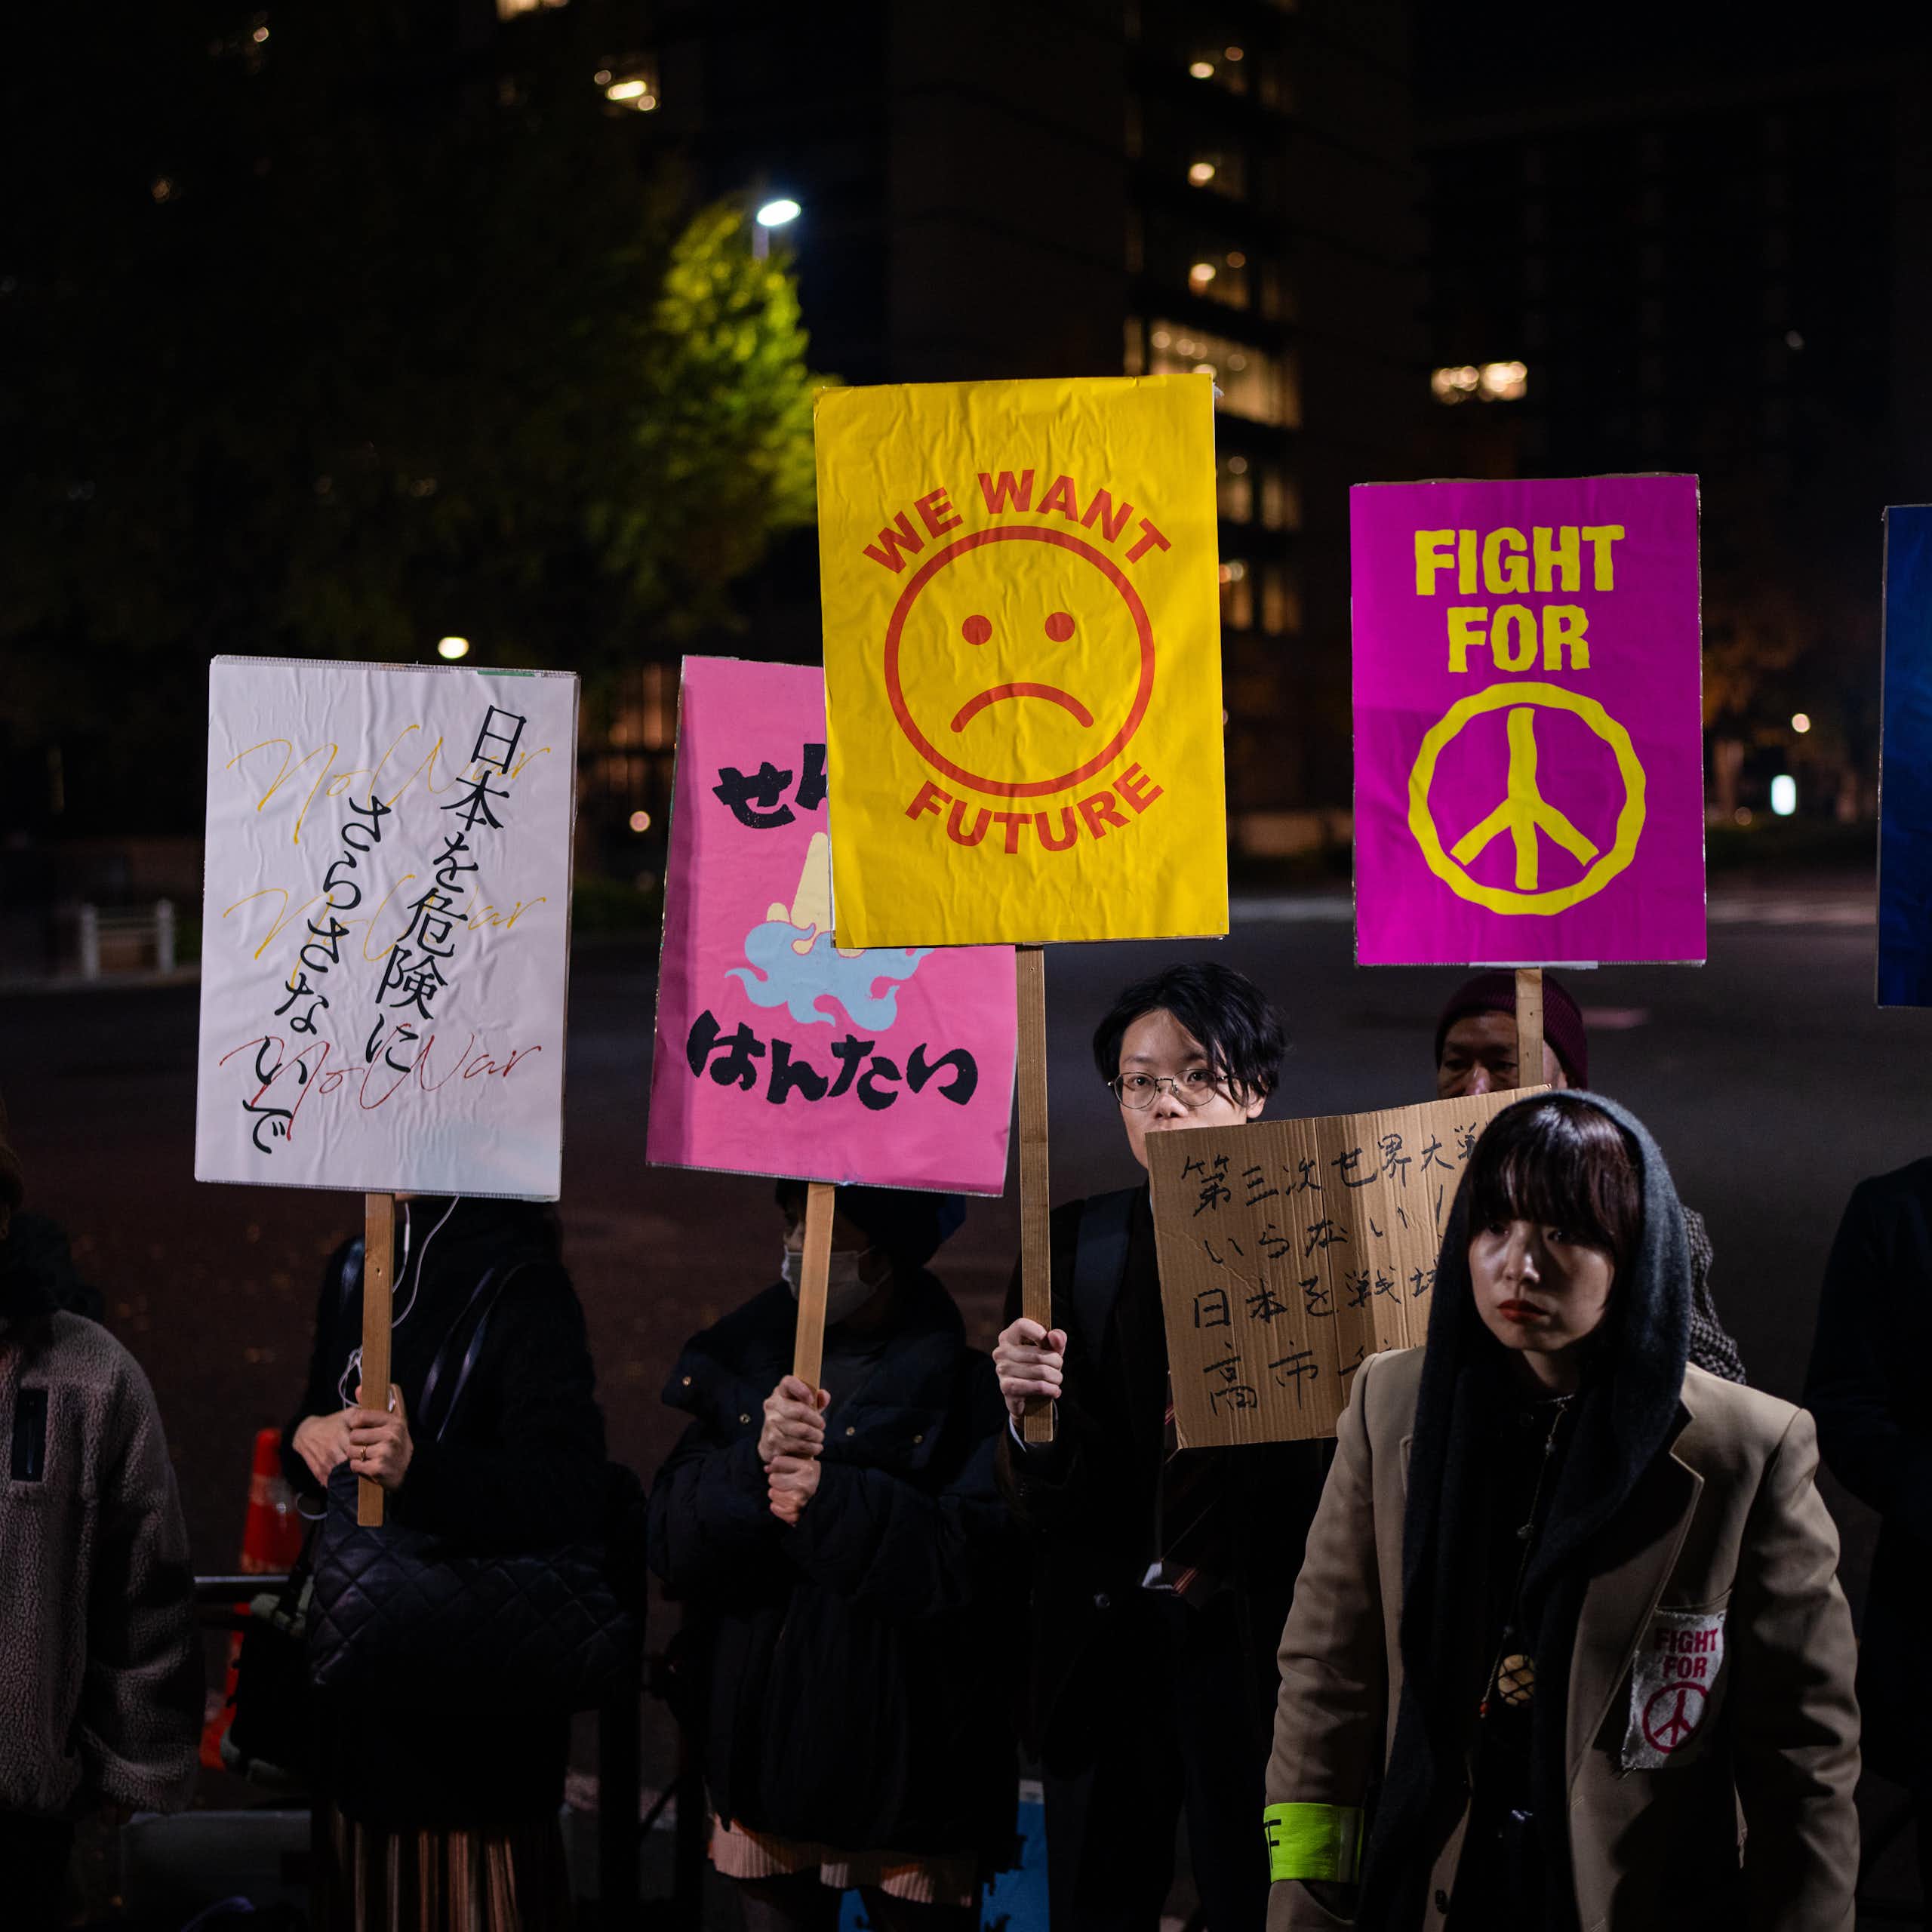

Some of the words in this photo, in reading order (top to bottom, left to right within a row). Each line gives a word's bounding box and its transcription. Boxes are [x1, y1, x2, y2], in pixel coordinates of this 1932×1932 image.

[863, 488, 964, 574] WE
[977, 469, 1172, 565] WANT
[1414, 525, 1625, 595] FIGHT
[1447, 604, 1590, 672] FOR
[906, 762, 1164, 854] FUTURE
[366, 705, 528, 1073] 日本を危険に
[242, 795, 391, 1154] さらさないで
[686, 1010, 978, 1111] はんたい
[1654, 1628, 1718, 1653] FIGHT
[1663, 1656, 1707, 1678] FOR
